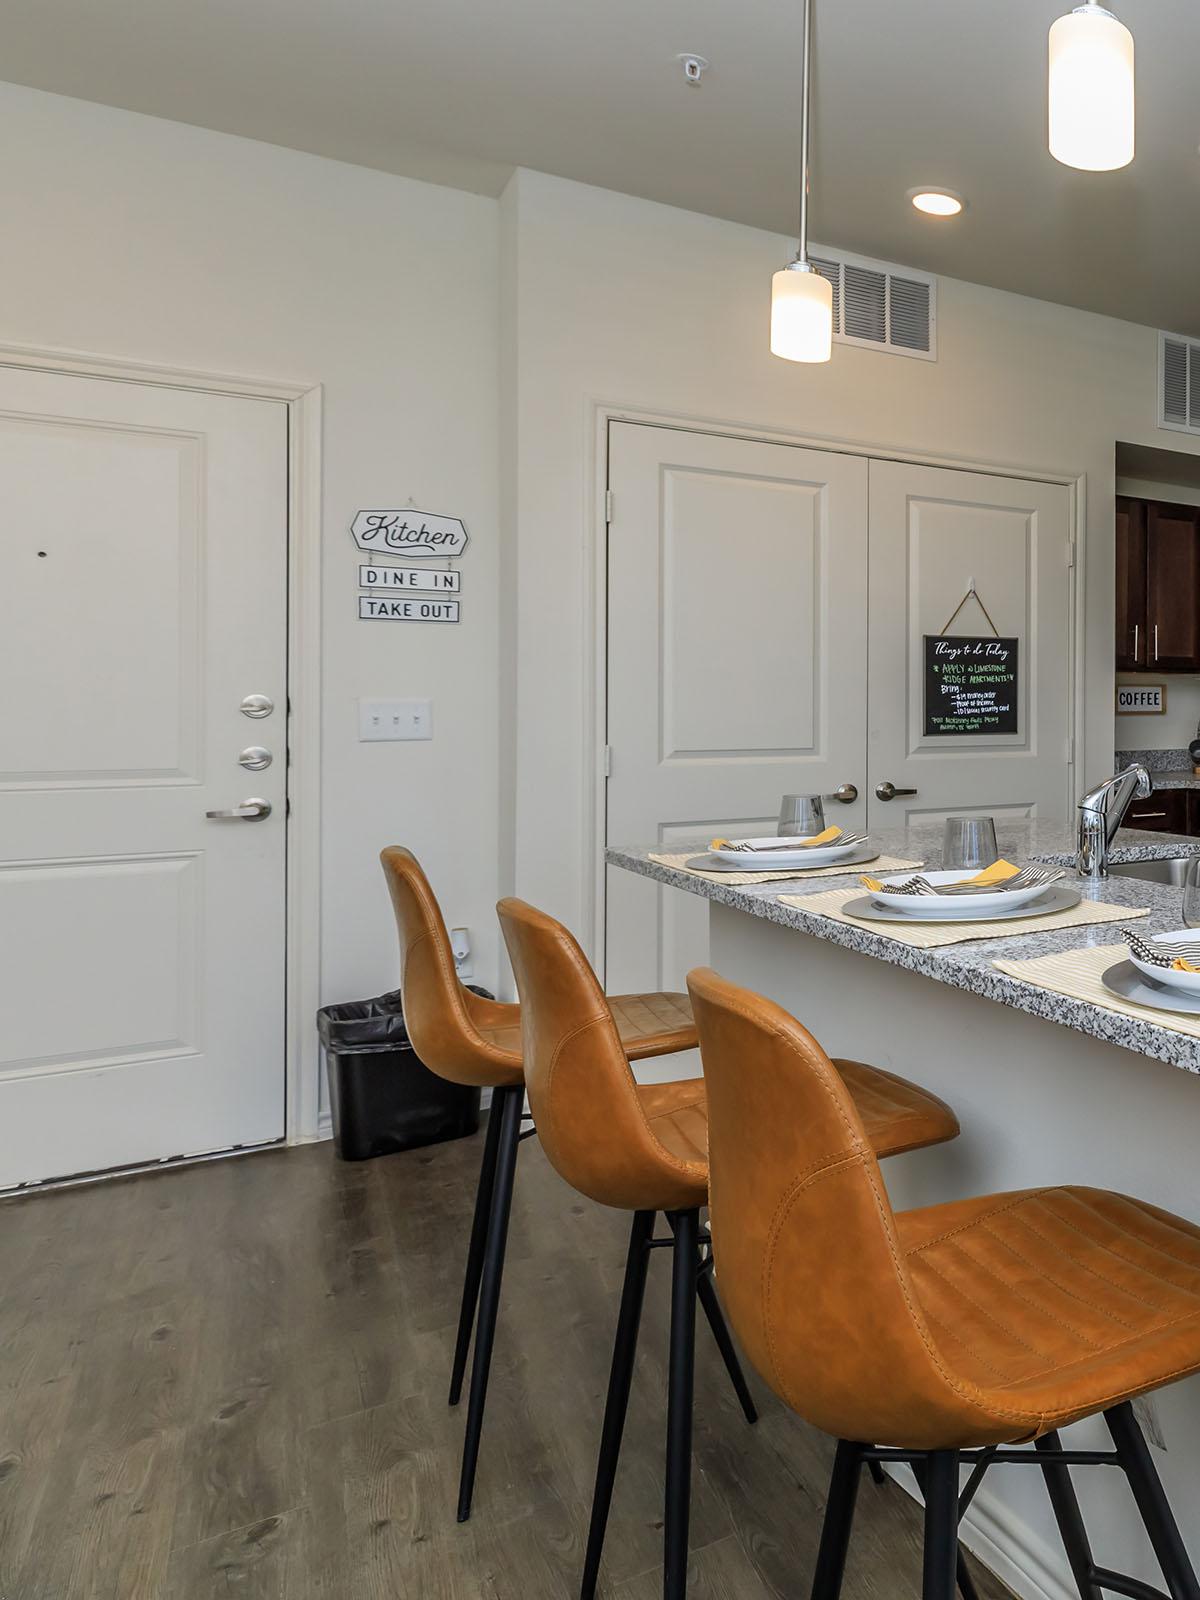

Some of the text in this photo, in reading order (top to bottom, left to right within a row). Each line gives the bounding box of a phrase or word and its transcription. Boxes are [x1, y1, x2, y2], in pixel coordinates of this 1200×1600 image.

[361, 516, 459, 551] Kitchen
[367, 570, 453, 587] DINE IN
[367, 602, 453, 618] TAKE OUT
[935, 642, 1010, 661] Things to do Today
[943, 663, 965, 674] APPLY
[1119, 692, 1160, 705] COFFEE
